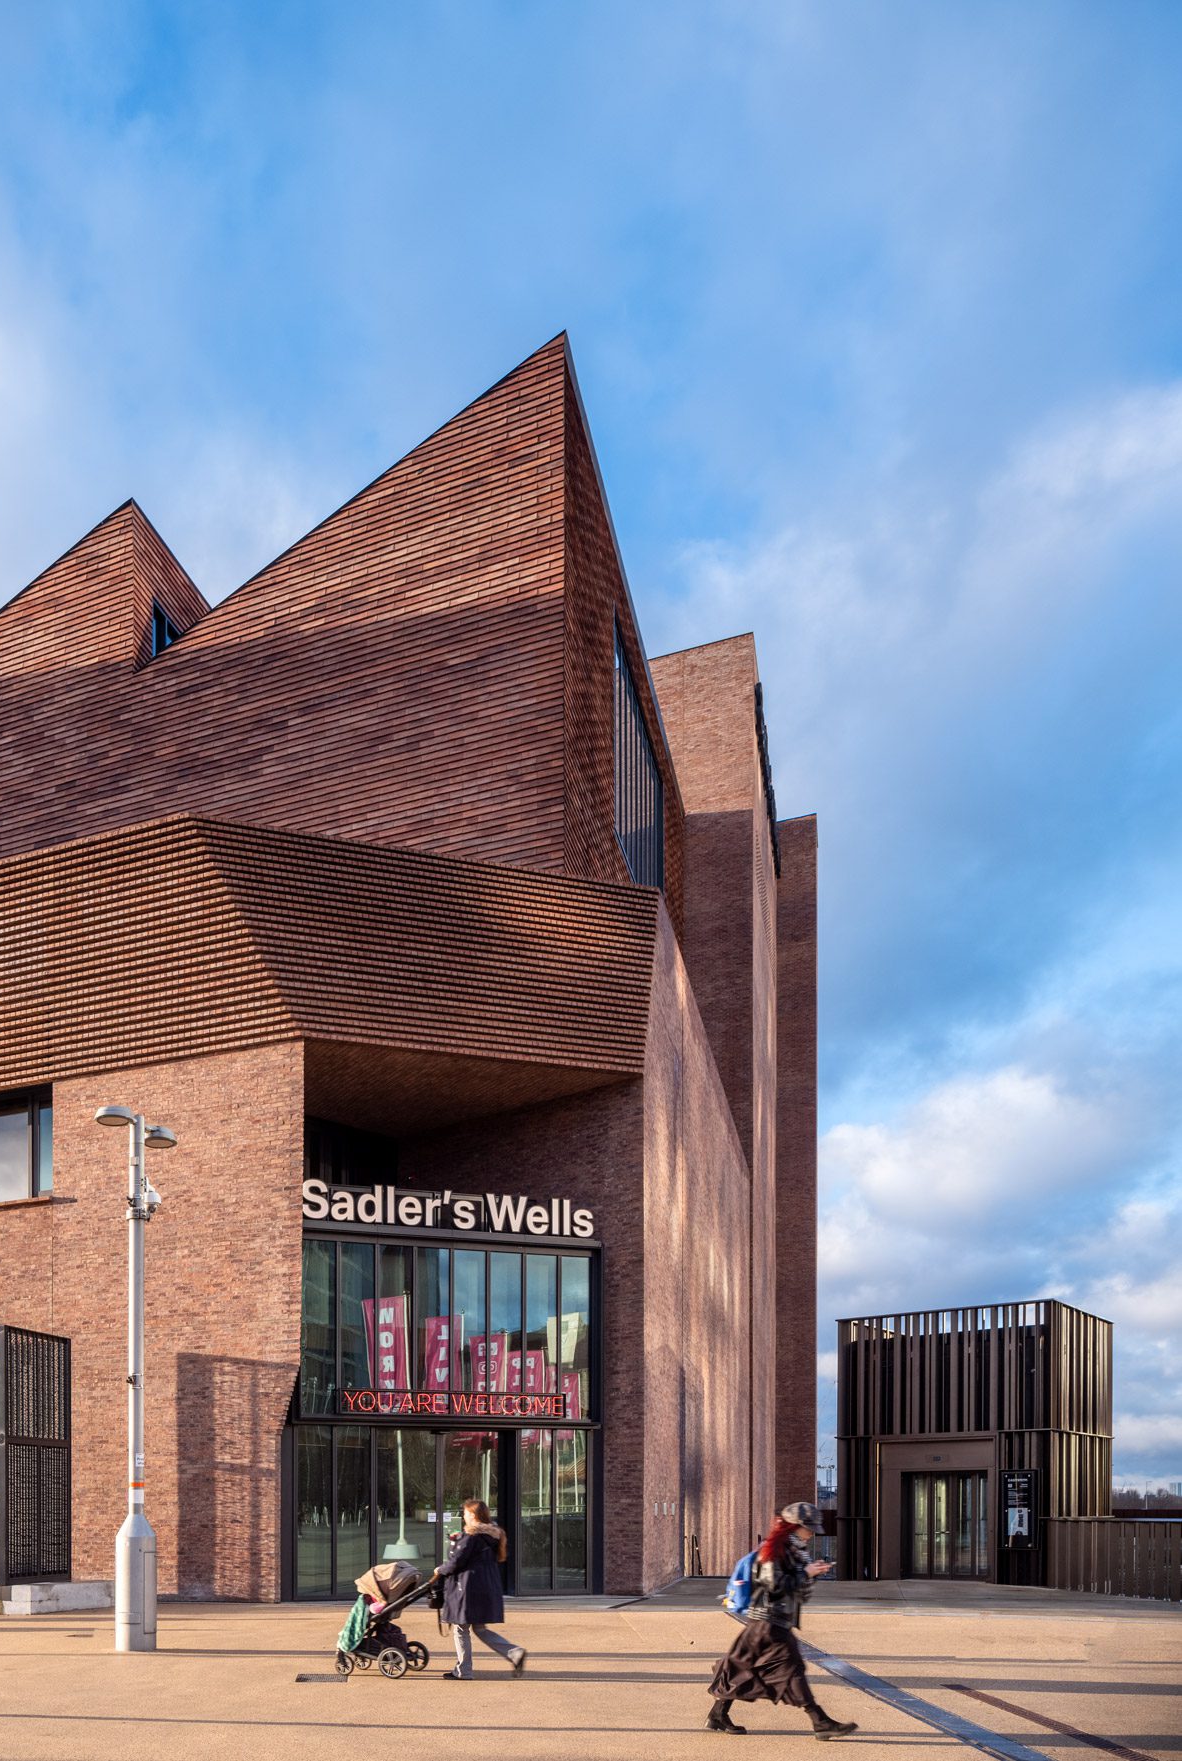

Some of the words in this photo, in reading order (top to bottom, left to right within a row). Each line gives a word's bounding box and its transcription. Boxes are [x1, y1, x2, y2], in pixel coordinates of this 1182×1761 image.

[302, 1178, 476, 1230] Sadler's
[485, 1192, 594, 1238] Wells
[343, 1390, 393, 1411] YOU
[399, 1392, 446, 1414] ARE
[451, 1393, 564, 1416] WELCOME
